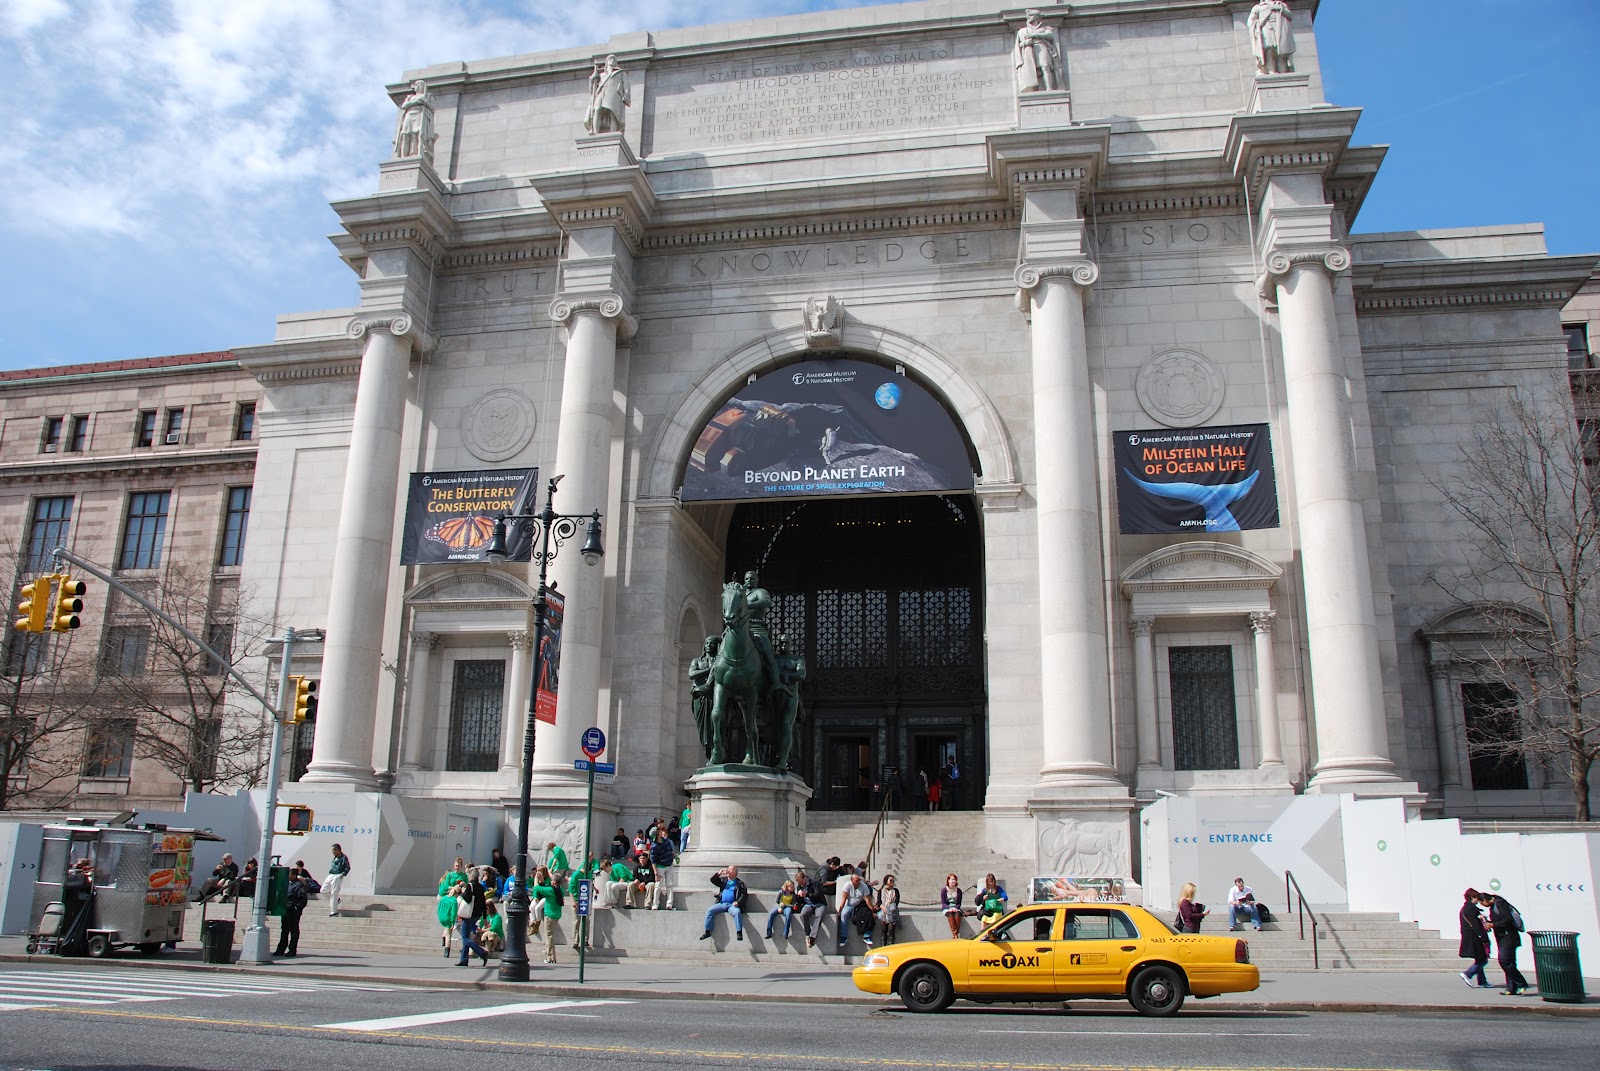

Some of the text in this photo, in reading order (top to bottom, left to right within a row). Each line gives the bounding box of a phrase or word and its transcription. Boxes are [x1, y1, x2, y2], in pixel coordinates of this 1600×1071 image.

[709, 49, 948, 82] STATE OF NEW YORK MEMORIAL TO
[737, 63, 919, 91] THEODORE ROOSEVELT
[693, 73, 965, 106] A GREAT LEADER OF THE YOUTH OF AMERICA
[1266, 88, 1302, 99] LEWIS
[681, 105, 722, 118] ENERGY
[726, 102, 749, 114] AND
[754, 95, 815, 110] FORTITUDE
[819, 94, 831, 103] IN
[837, 91, 857, 102] THE
[861, 87, 894, 99] FAITH
[898, 86, 912, 96] OF
[917, 84, 942, 94] OUR
[946, 80, 993, 92] FATHERS
[699, 92, 957, 126] IN DEFENSE OF THE RIGHTS OF THE PEOPLE
[1027, 105, 1063, 116] CLARK
[690, 101, 969, 136] IN THE LOVE AND CONSERVATION OF NATURE
[710, 113, 946, 144] AND OF THE BEST IN LIFE AND IN MAN
[1090, 220, 1241, 249] VISION
[689, 237, 970, 279] KNOWLEDGE
[449, 271, 547, 299] TRUT
[833, 370, 857, 378] MUSEUM
[1142, 436, 1171, 444] AMERICAN
[1172, 434, 1199, 442] MUSEUM
[1204, 432, 1230, 440] NATURAL
[1230, 431, 1254, 439] HISTORY
[1142, 444, 1246, 461] MILSTEIN HALL
[745, 465, 906, 484] BEYOND PLANET EARTH
[1145, 458, 1246, 475] OF OCEAN LIFE
[483, 475, 505, 483] NATURAL
[505, 474, 526, 482] HISTORY
[816, 482, 837, 490] SPACE
[837, 480, 885, 490] EXPLORATION
[432, 487, 517, 500] THE BUTTERFLY
[427, 499, 515, 513] CONSERVATORY
[1179, 519, 1217, 528] AMNH.ORG
[407, 829, 433, 840] ENTRANCE
[1209, 833, 1272, 843] ENTRANCE
[979, 955, 1040, 968] NYC TAXI
